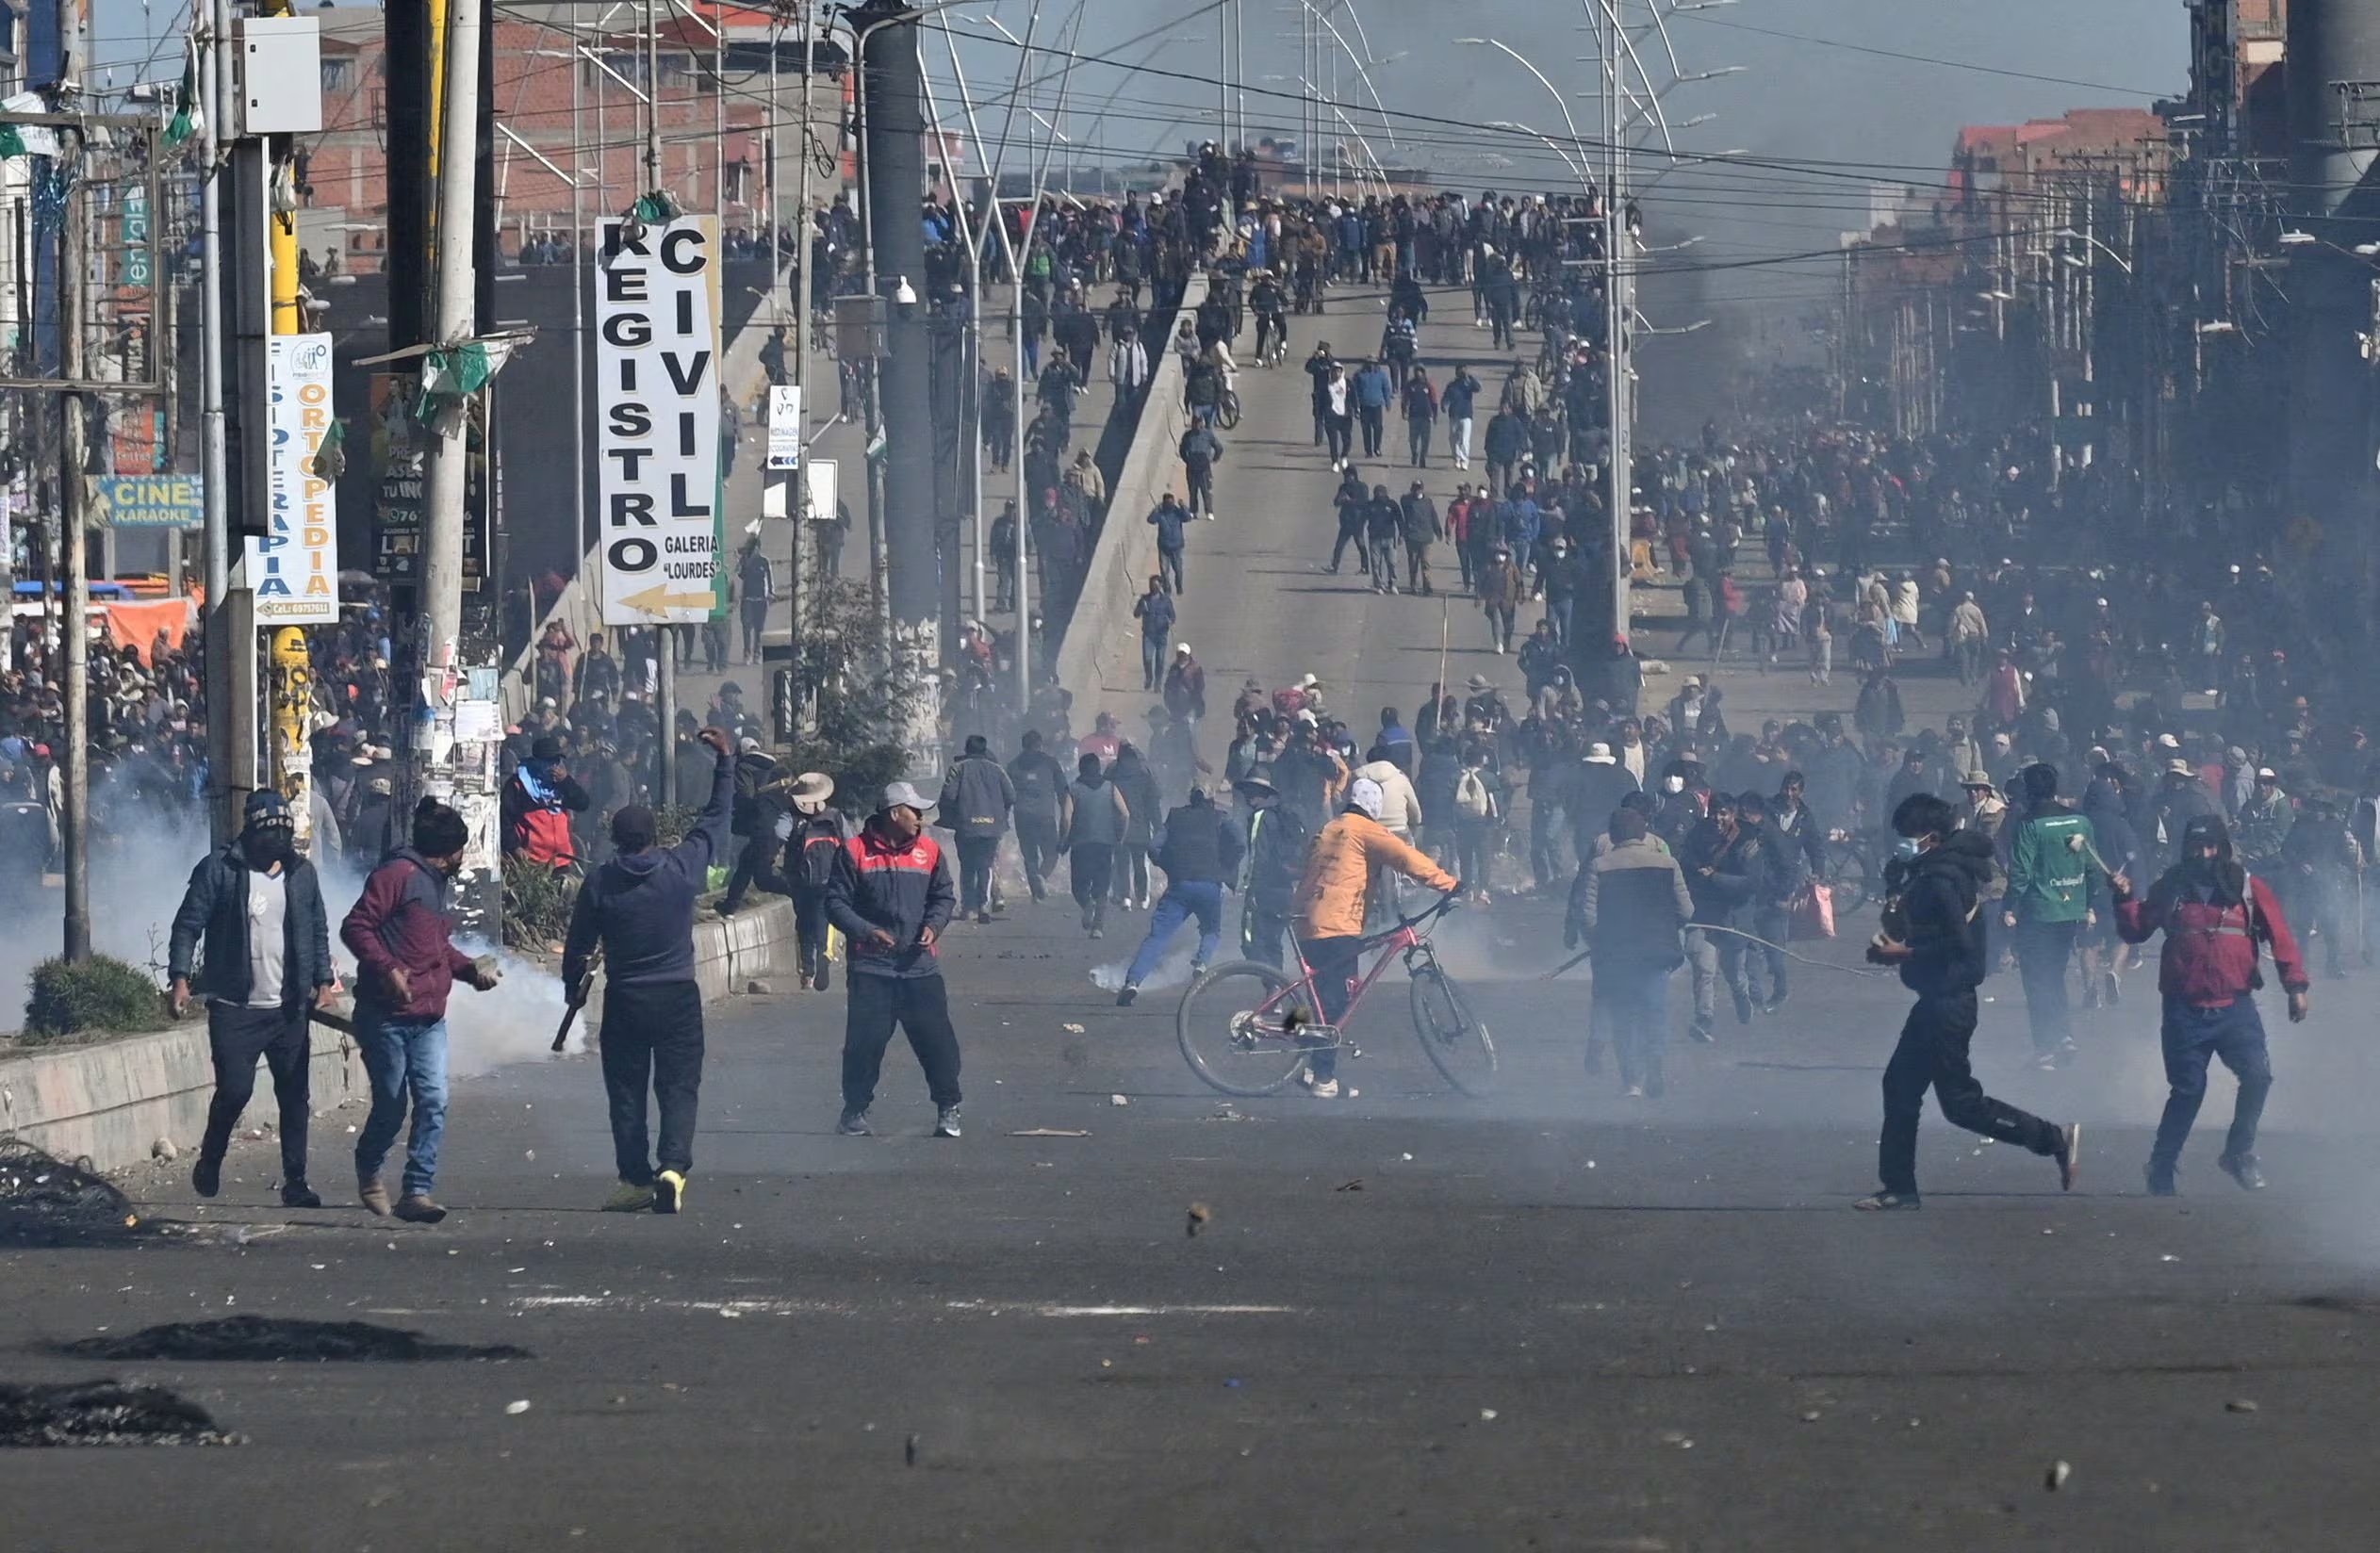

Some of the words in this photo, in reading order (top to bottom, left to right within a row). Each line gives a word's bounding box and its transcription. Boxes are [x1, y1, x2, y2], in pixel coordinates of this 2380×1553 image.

[602, 223, 658, 572] REGISTRO
[660, 229, 712, 517] CIVIL
[114, 482, 190, 506] CINE
[115, 508, 190, 522] KARAOKE
[298, 384, 331, 595] ORTOPEDIA
[665, 535, 718, 553] GALERIA
